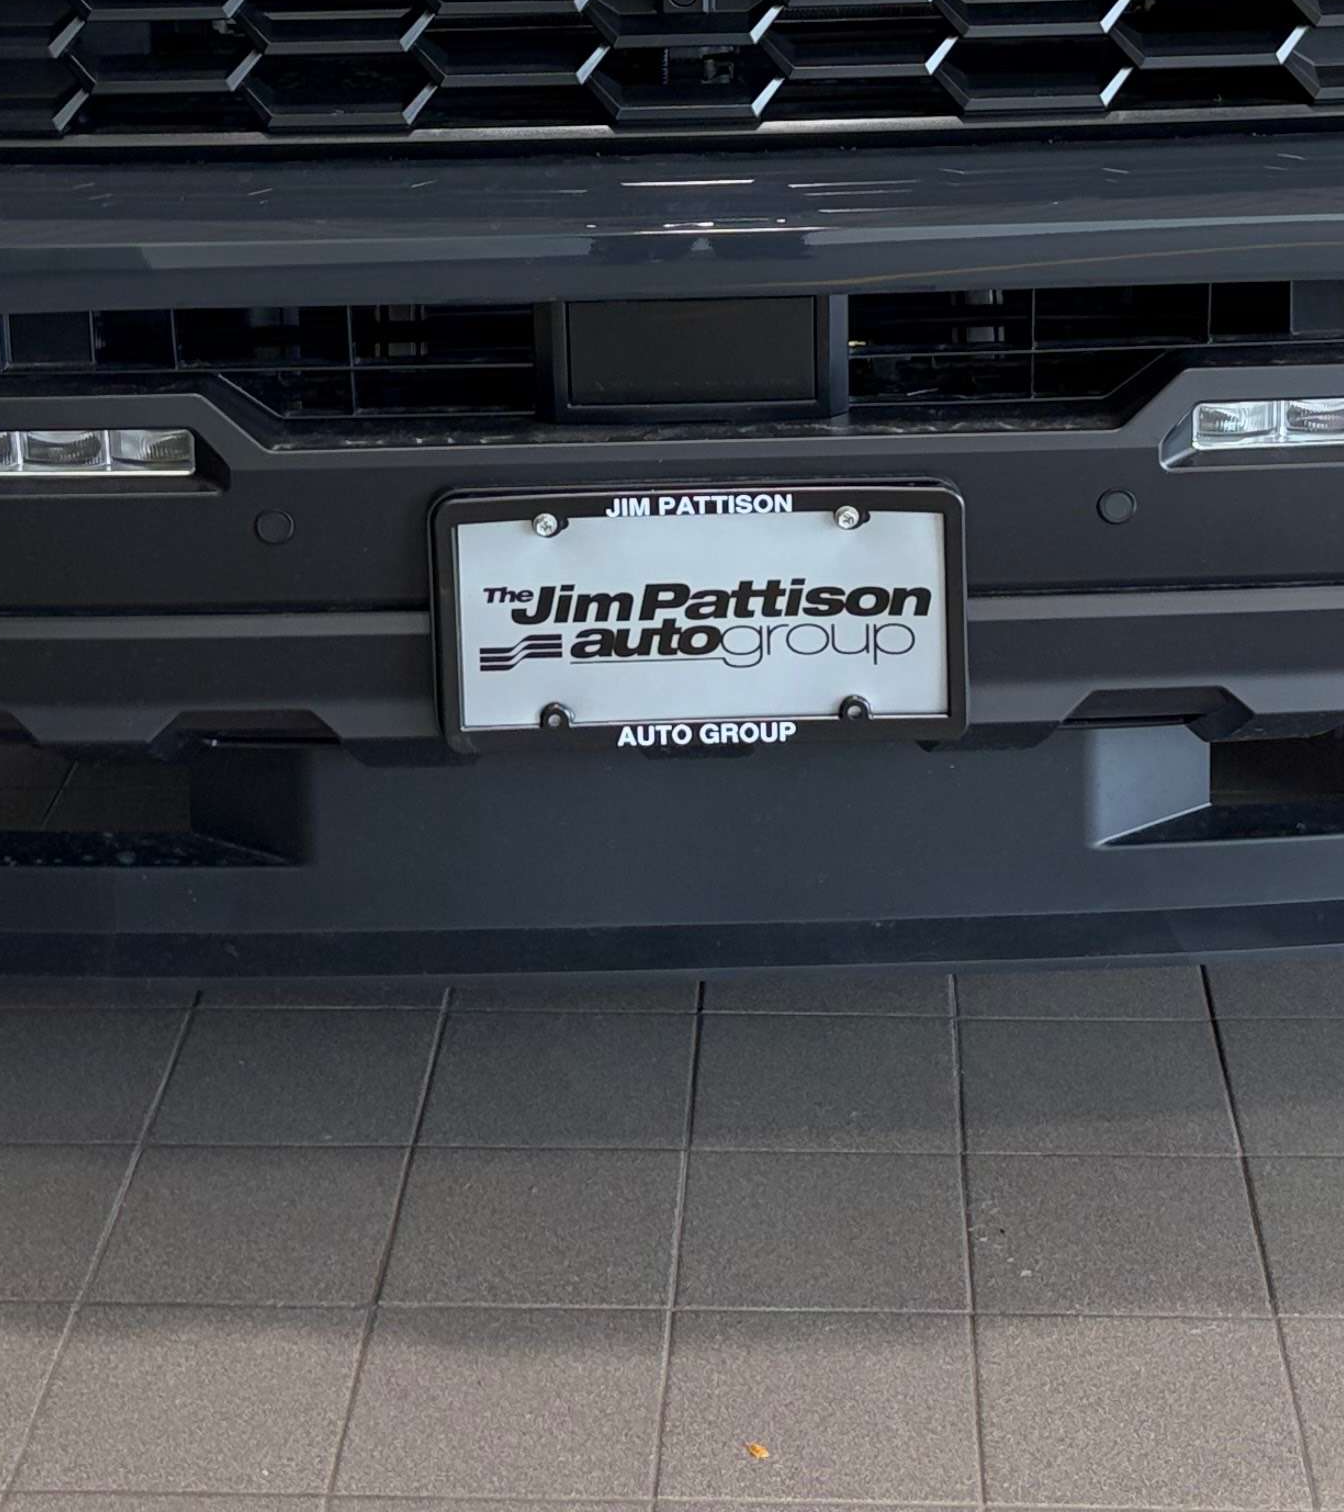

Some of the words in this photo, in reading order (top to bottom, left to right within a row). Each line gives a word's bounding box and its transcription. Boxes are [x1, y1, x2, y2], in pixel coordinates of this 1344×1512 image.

[605, 497, 650, 518] JIM
[658, 493, 794, 516] PATTISON
[482, 585, 534, 605] The
[616, 724, 693, 747] AUTO
[698, 721, 798, 745] GROUP
